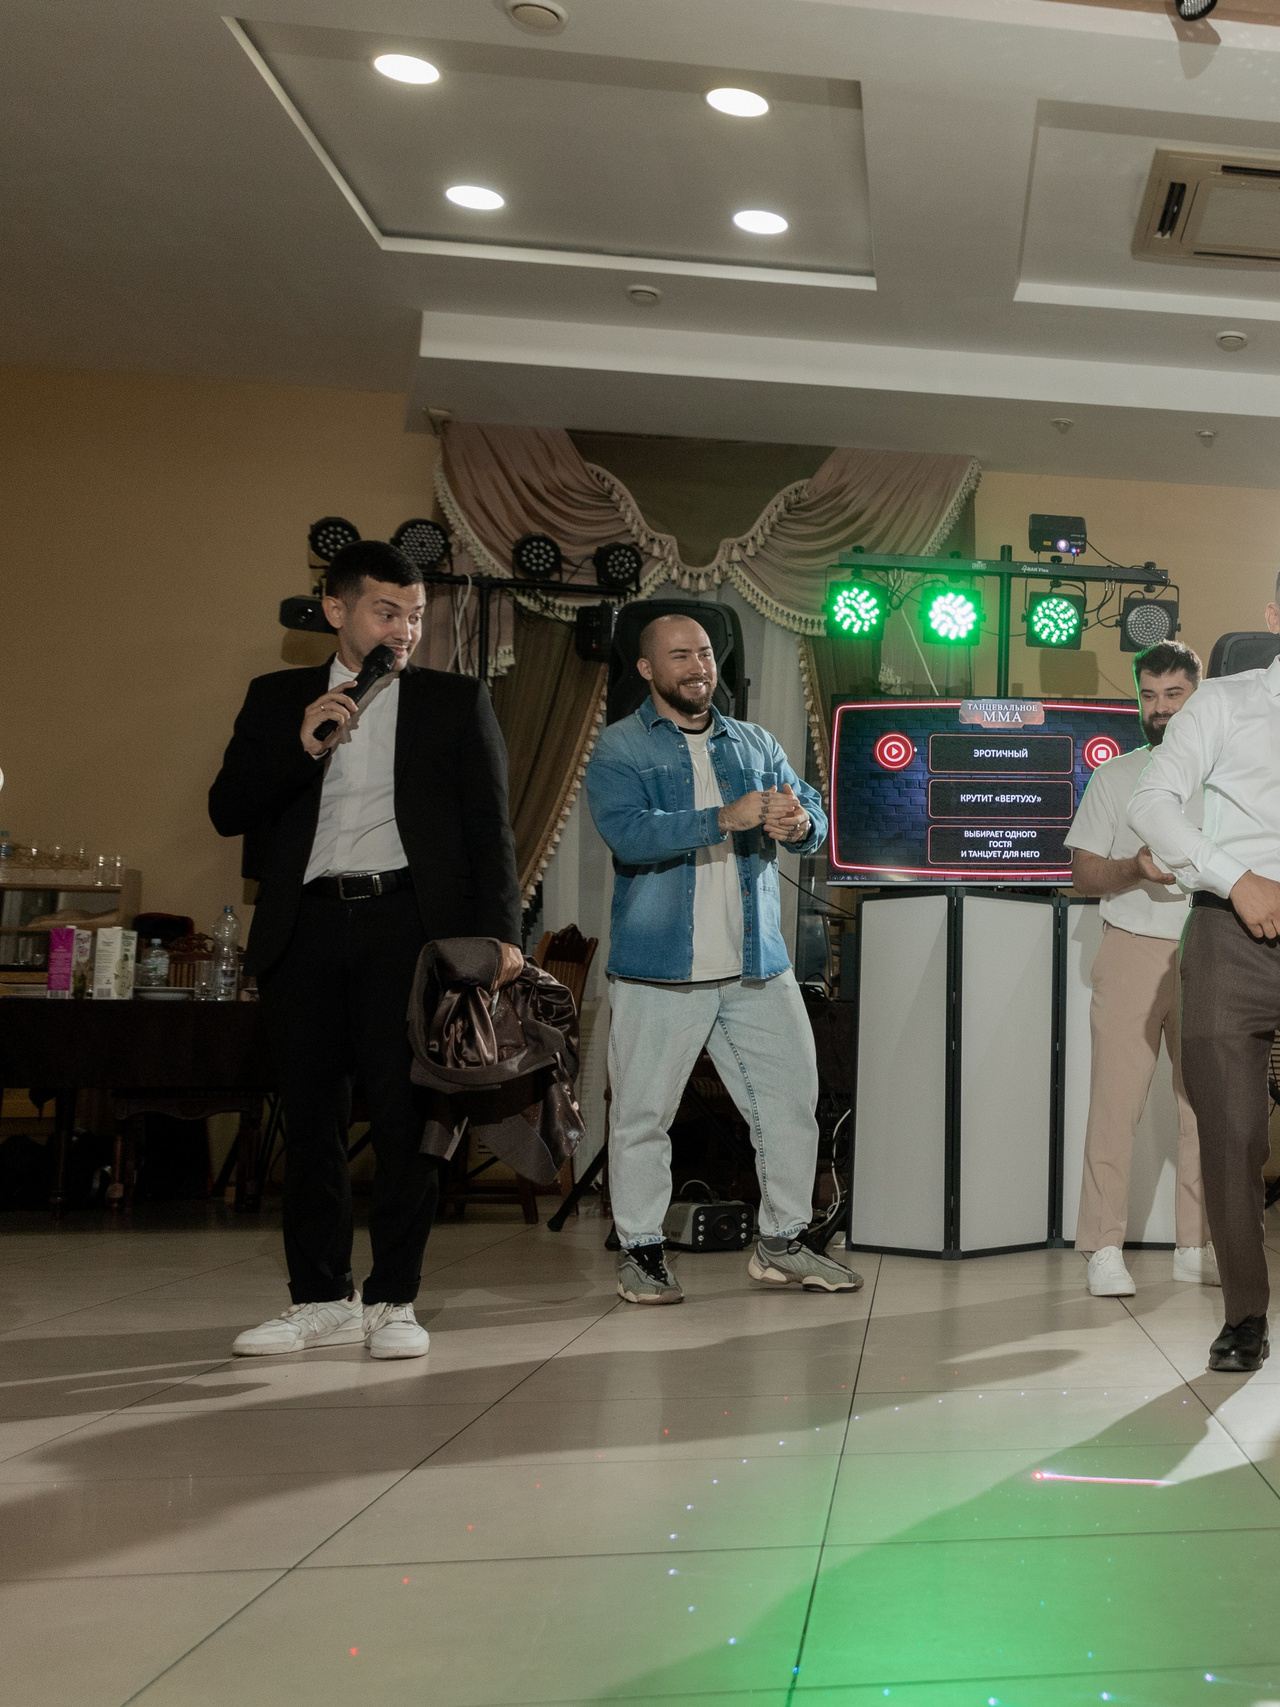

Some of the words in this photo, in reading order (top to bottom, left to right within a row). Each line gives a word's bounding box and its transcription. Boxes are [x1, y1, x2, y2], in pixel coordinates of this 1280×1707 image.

[967, 703, 1038, 712] ТАНЦЕВАЛЬНОЕ
[983, 711, 1023, 723] ММА
[973, 748, 1029, 758] ЭРОТИЧНЫЙ
[960, 794, 994, 803] КРУТИТ
[994, 794, 1042, 803] «ВЕРТУХУ»
[964, 830, 1004, 838] ВЫБИРАЕТ
[1004, 830, 1037, 839] ОДНОГО
[988, 840, 1013, 848] ГОСТЯ
[960, 850, 967, 858] И
[967, 850, 1002, 859] ТАНЦУЕТ
[1002, 850, 1019, 859] ДЛЯ
[1020, 850, 1040, 858] НЕГО
